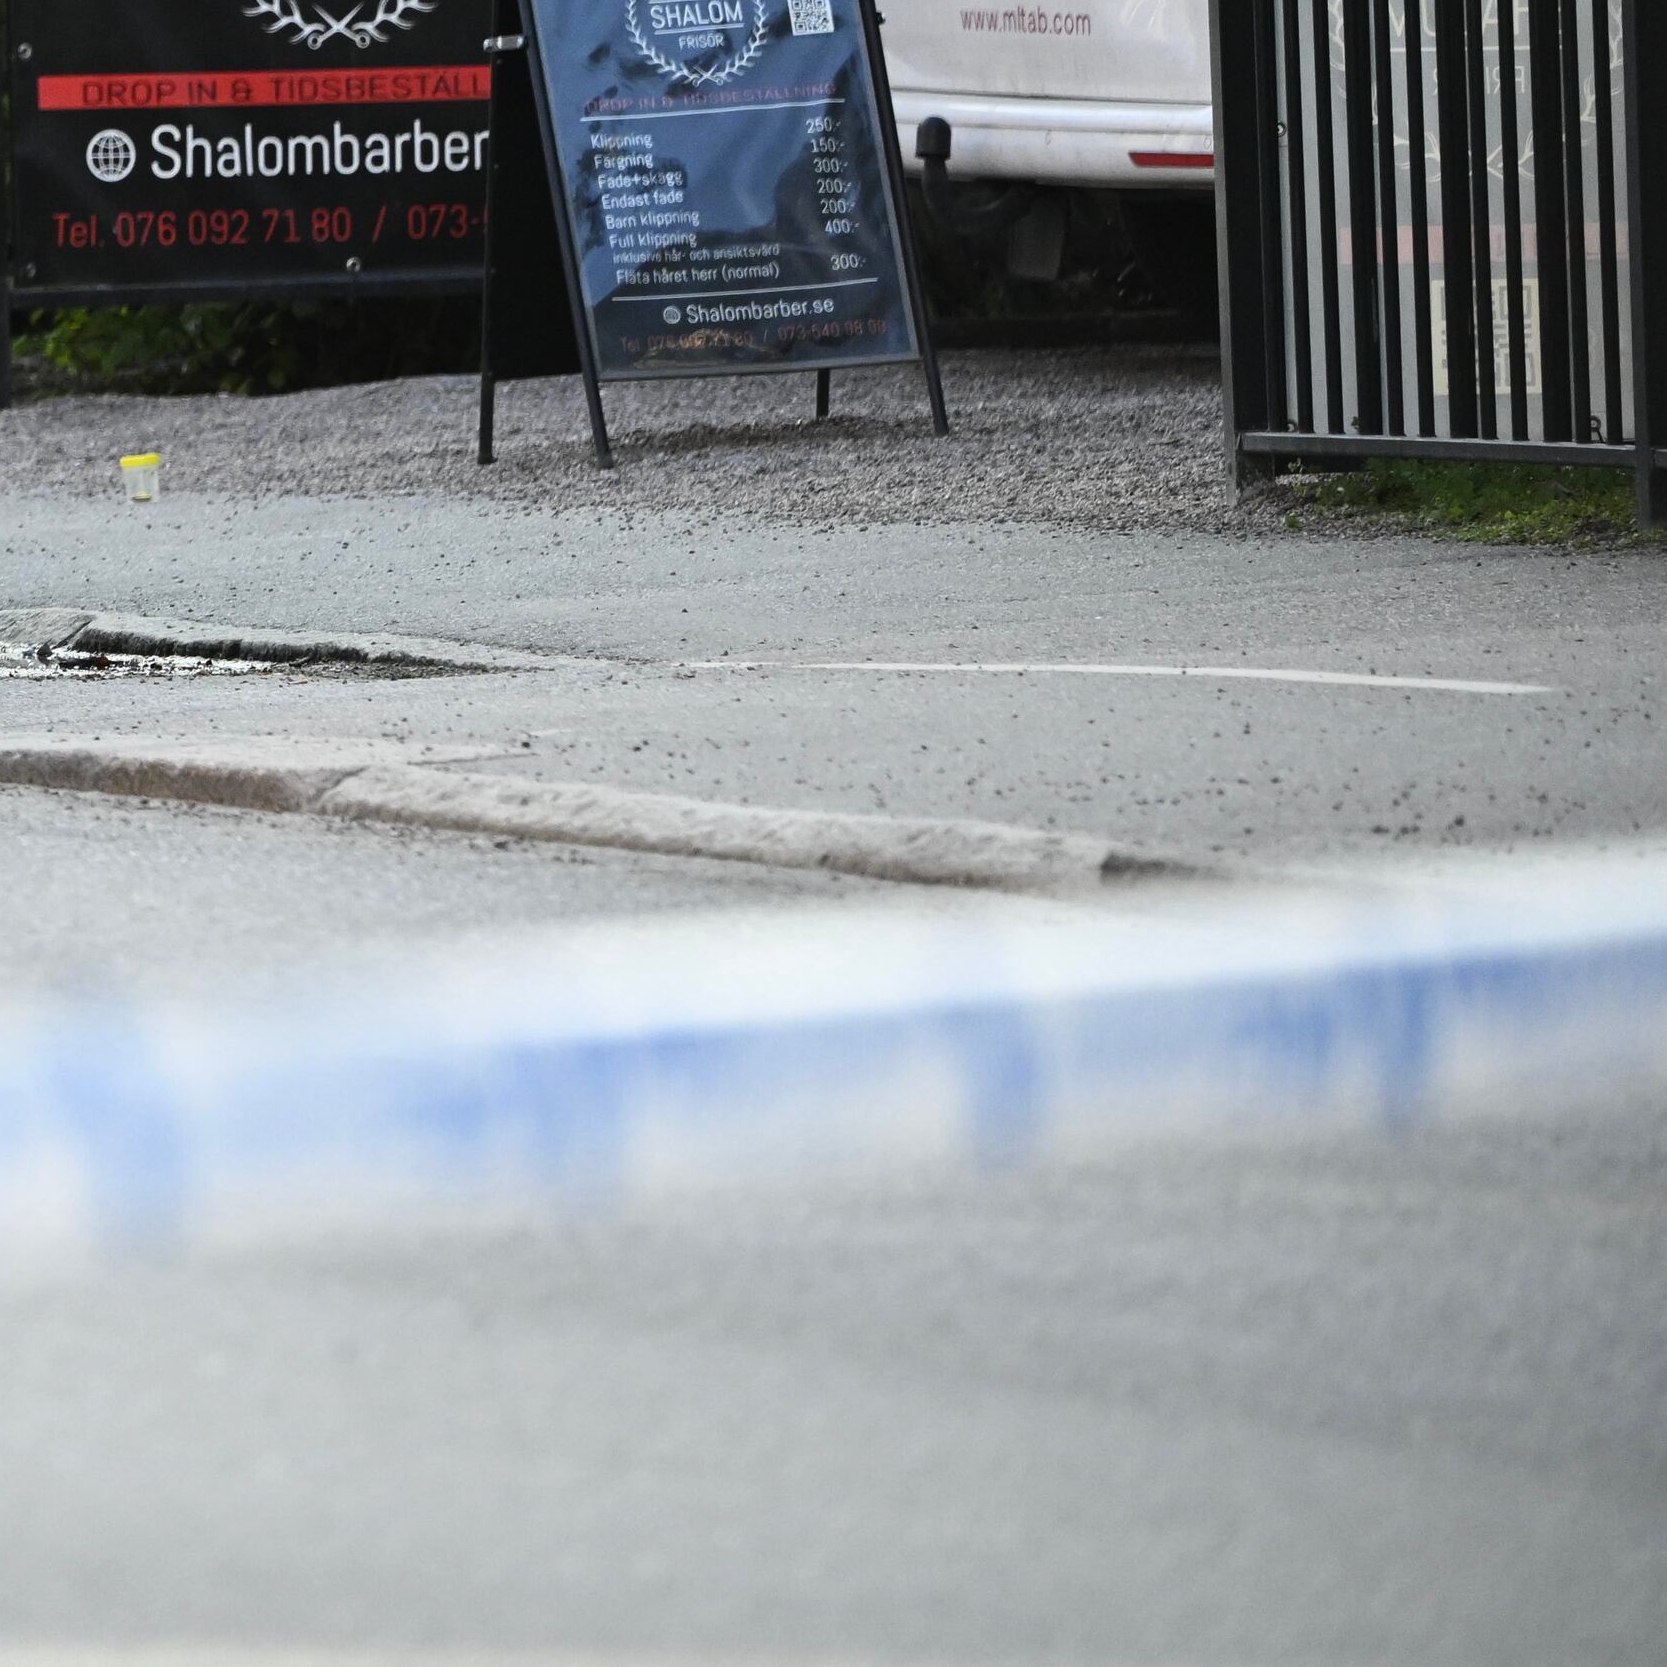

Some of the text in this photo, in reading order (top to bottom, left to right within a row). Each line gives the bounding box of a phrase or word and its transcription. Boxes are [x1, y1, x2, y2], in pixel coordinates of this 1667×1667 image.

[650, 0, 744, 30] SHALOM
[959, 5, 1092, 35] www.mltab.com
[678, 31, 725, 50] FRISÖR
[82, 80, 177, 106] DROP
[188, 80, 217, 105] IN
[591, 133, 653, 150] Klippning
[602, 194, 649, 210] Endast
[654, 189, 684, 205] fade
[116, 209, 178, 248] 076
[188, 208, 250, 246] 092
[262, 208, 301, 244] 71
[310, 206, 354, 244] 80
[408, 203, 490, 241] 073-
[605, 215, 637, 230] Barn
[640, 211, 700, 227] klippning
[609, 234, 634, 248] Full
[638, 232, 697, 248] klippning
[691, 266, 718, 282] herr
[721, 262, 780, 283] (normal)
[686, 297, 835, 324] Shalombarber.se
